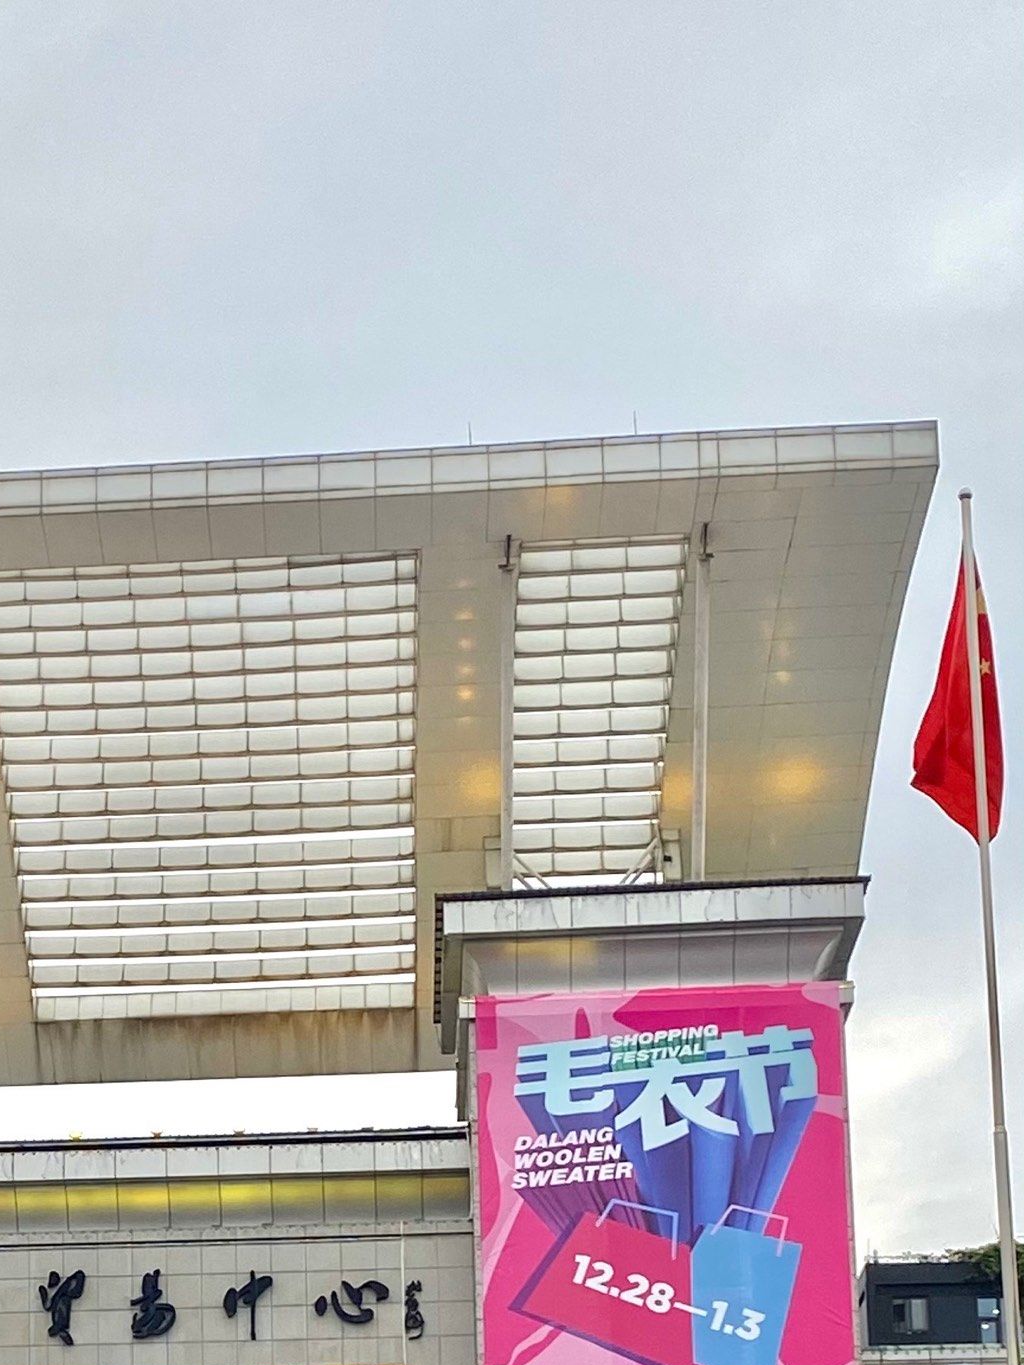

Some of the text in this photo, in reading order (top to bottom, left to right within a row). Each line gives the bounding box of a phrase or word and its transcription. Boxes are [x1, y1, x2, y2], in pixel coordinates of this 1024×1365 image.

[609, 1023, 719, 1048] SHOPPING
[610, 1043, 706, 1064] FESTIVAL
[514, 1025, 818, 1152] 毛衣节
[515, 1127, 615, 1152] DALANG
[515, 1144, 622, 1170] WOOLEN
[511, 1162, 633, 1190] SWEATER
